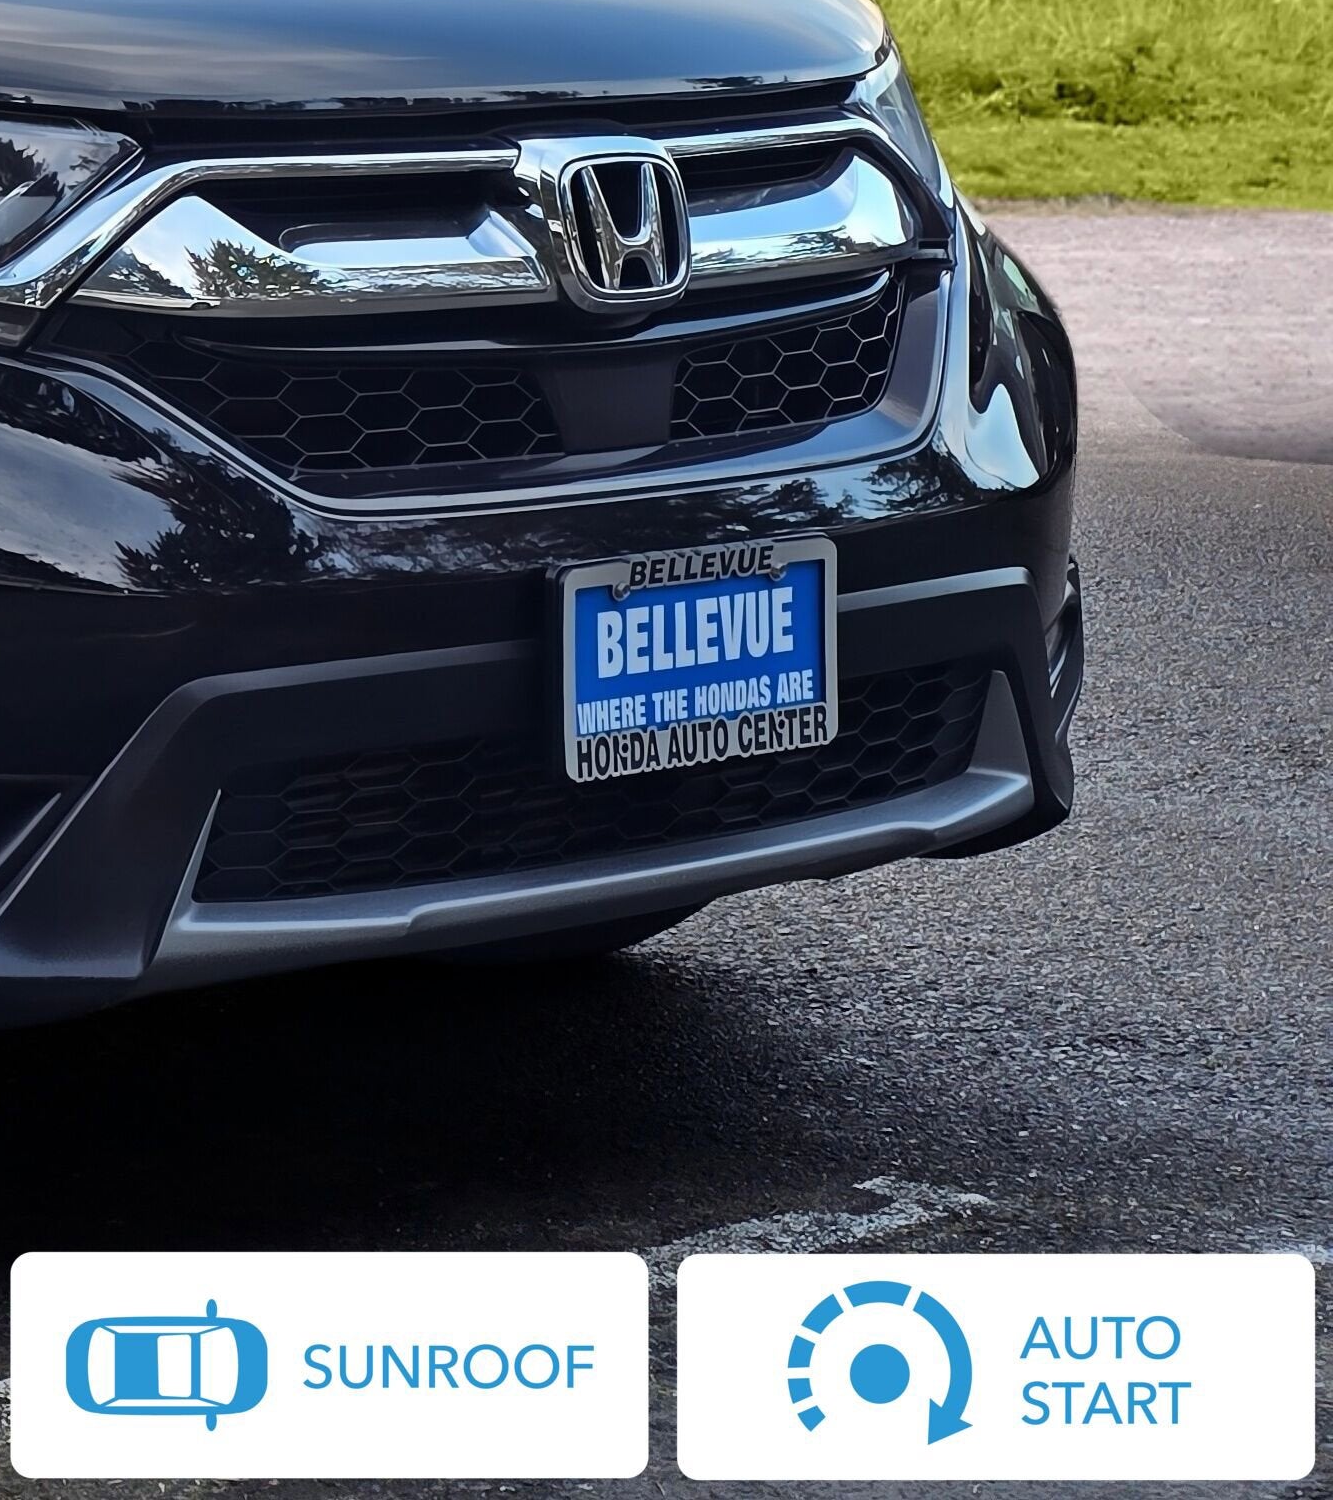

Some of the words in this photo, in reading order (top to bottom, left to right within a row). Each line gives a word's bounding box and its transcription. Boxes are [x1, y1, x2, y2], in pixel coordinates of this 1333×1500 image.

[630, 545, 774, 587] BELLEVUE
[597, 587, 794, 679] BELLEVUE
[577, 694, 647, 735] WHERE
[652, 688, 688, 723] THE
[694, 674, 771, 717] HONDAS
[776, 668, 814, 704] ARE
[576, 729, 661, 779] HONDA
[667, 718, 729, 765] AUTO
[738, 705, 828, 754] CENTER
